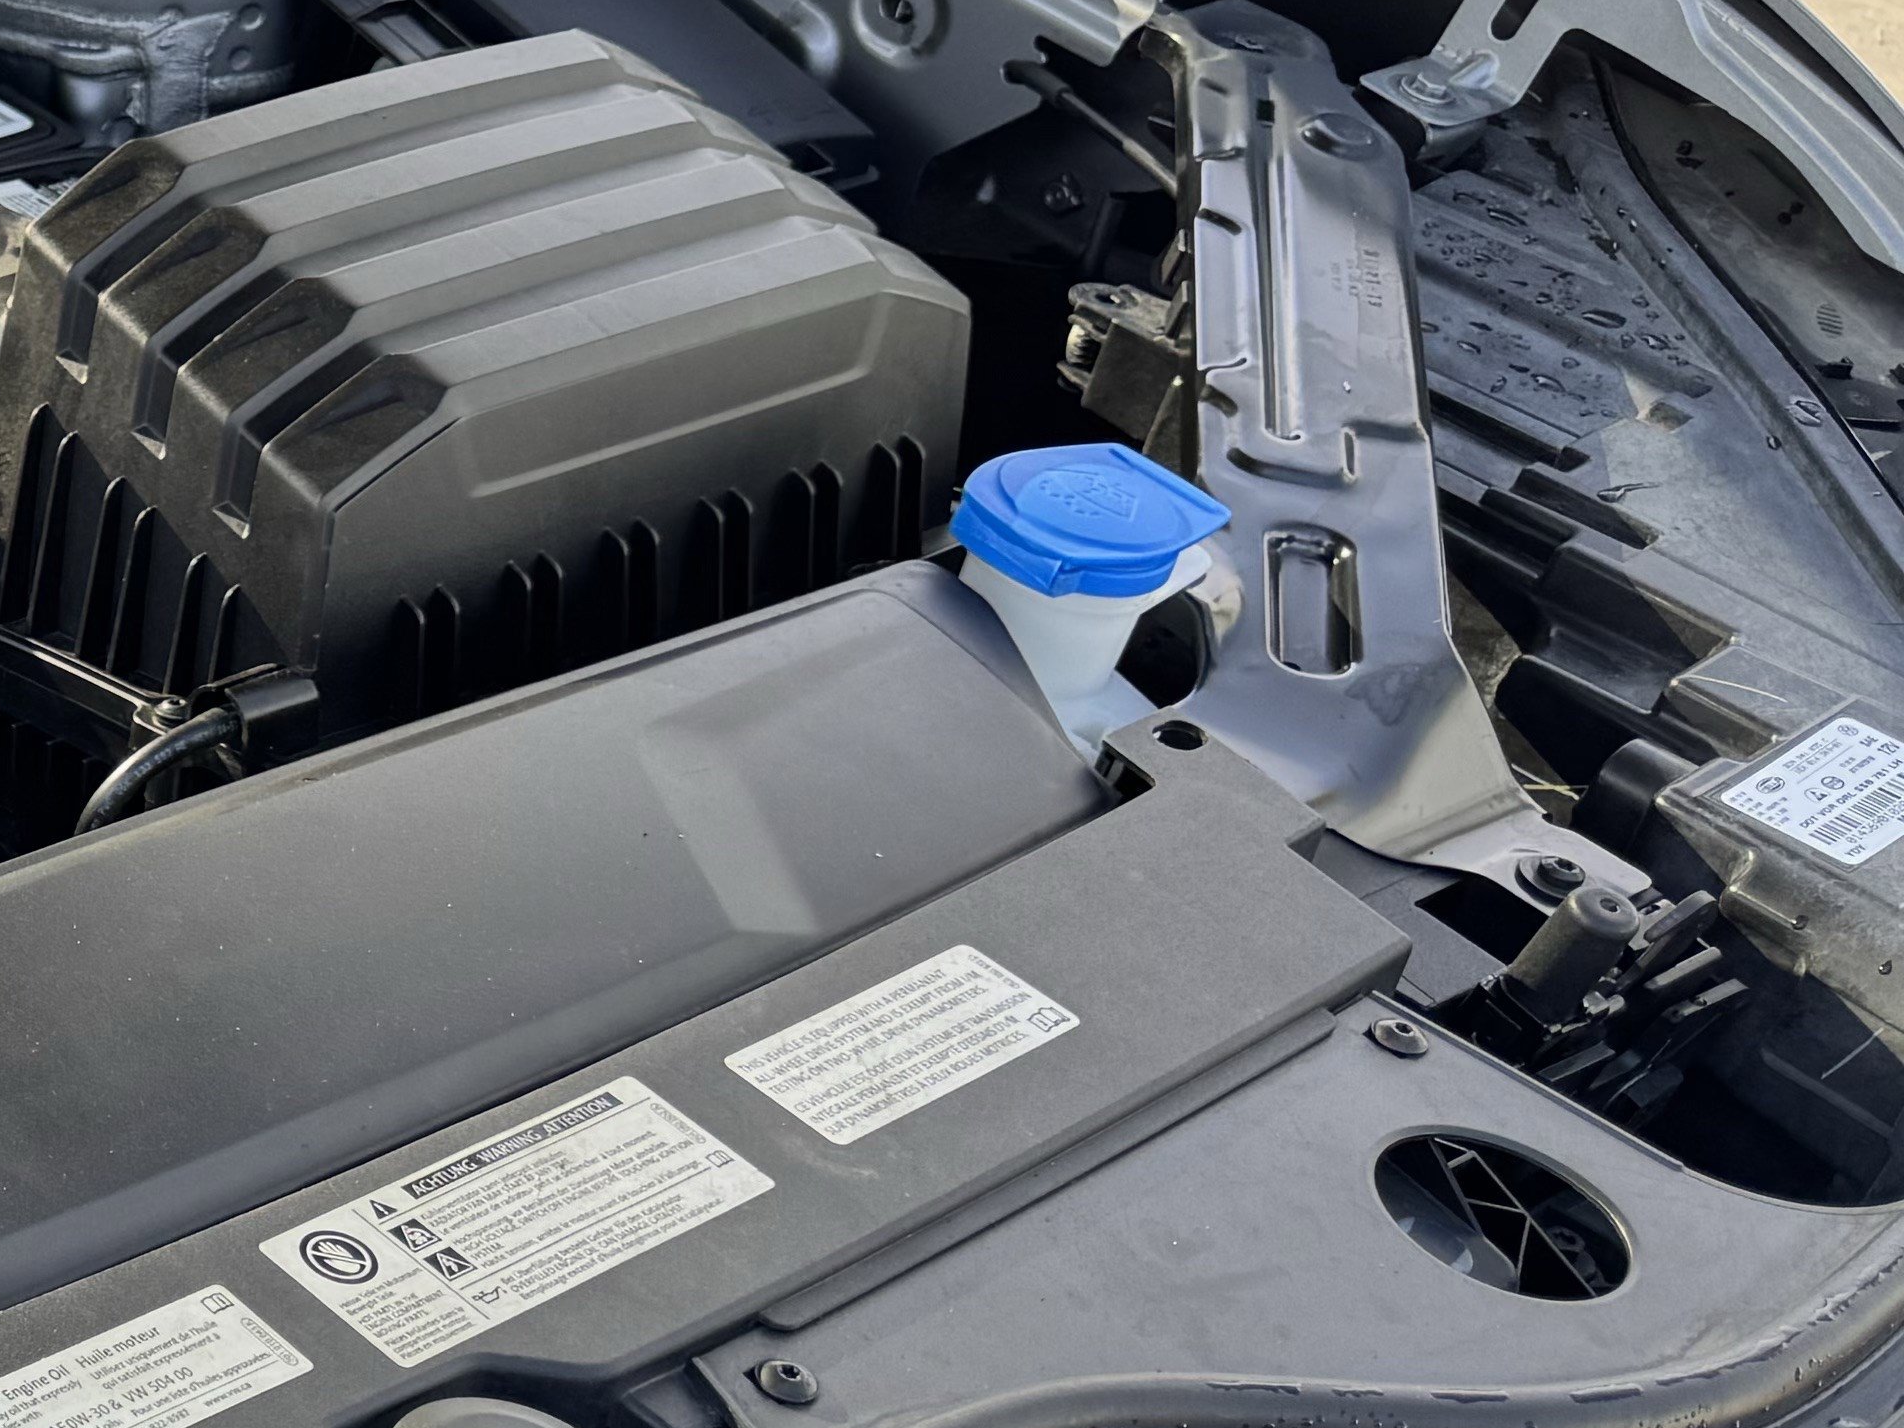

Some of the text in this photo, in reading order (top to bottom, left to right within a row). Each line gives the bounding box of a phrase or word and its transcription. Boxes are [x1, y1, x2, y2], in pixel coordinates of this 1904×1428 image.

[888, 968, 945, 1000] PERMANENT
[412, 1160, 477, 1195] ACHTUNG
[477, 1130, 541, 1165] WARNING
[543, 1097, 611, 1136] ATTENTION
[1, 1327, 159, 1400] Engine Oil Huile moteur
[7, 1403, 22, 1415] oil
[18, 1397, 41, 1410] that
[40, 1379, 82, 1401] expressly
[107, 1398, 123, 1410] &
[121, 1385, 148, 1402] VW
[146, 1374, 175, 1392] 504
[172, 1366, 193, 1380] 00
[19, 1410, 42, 1424] with
[129, 1403, 153, 1417] Pour
